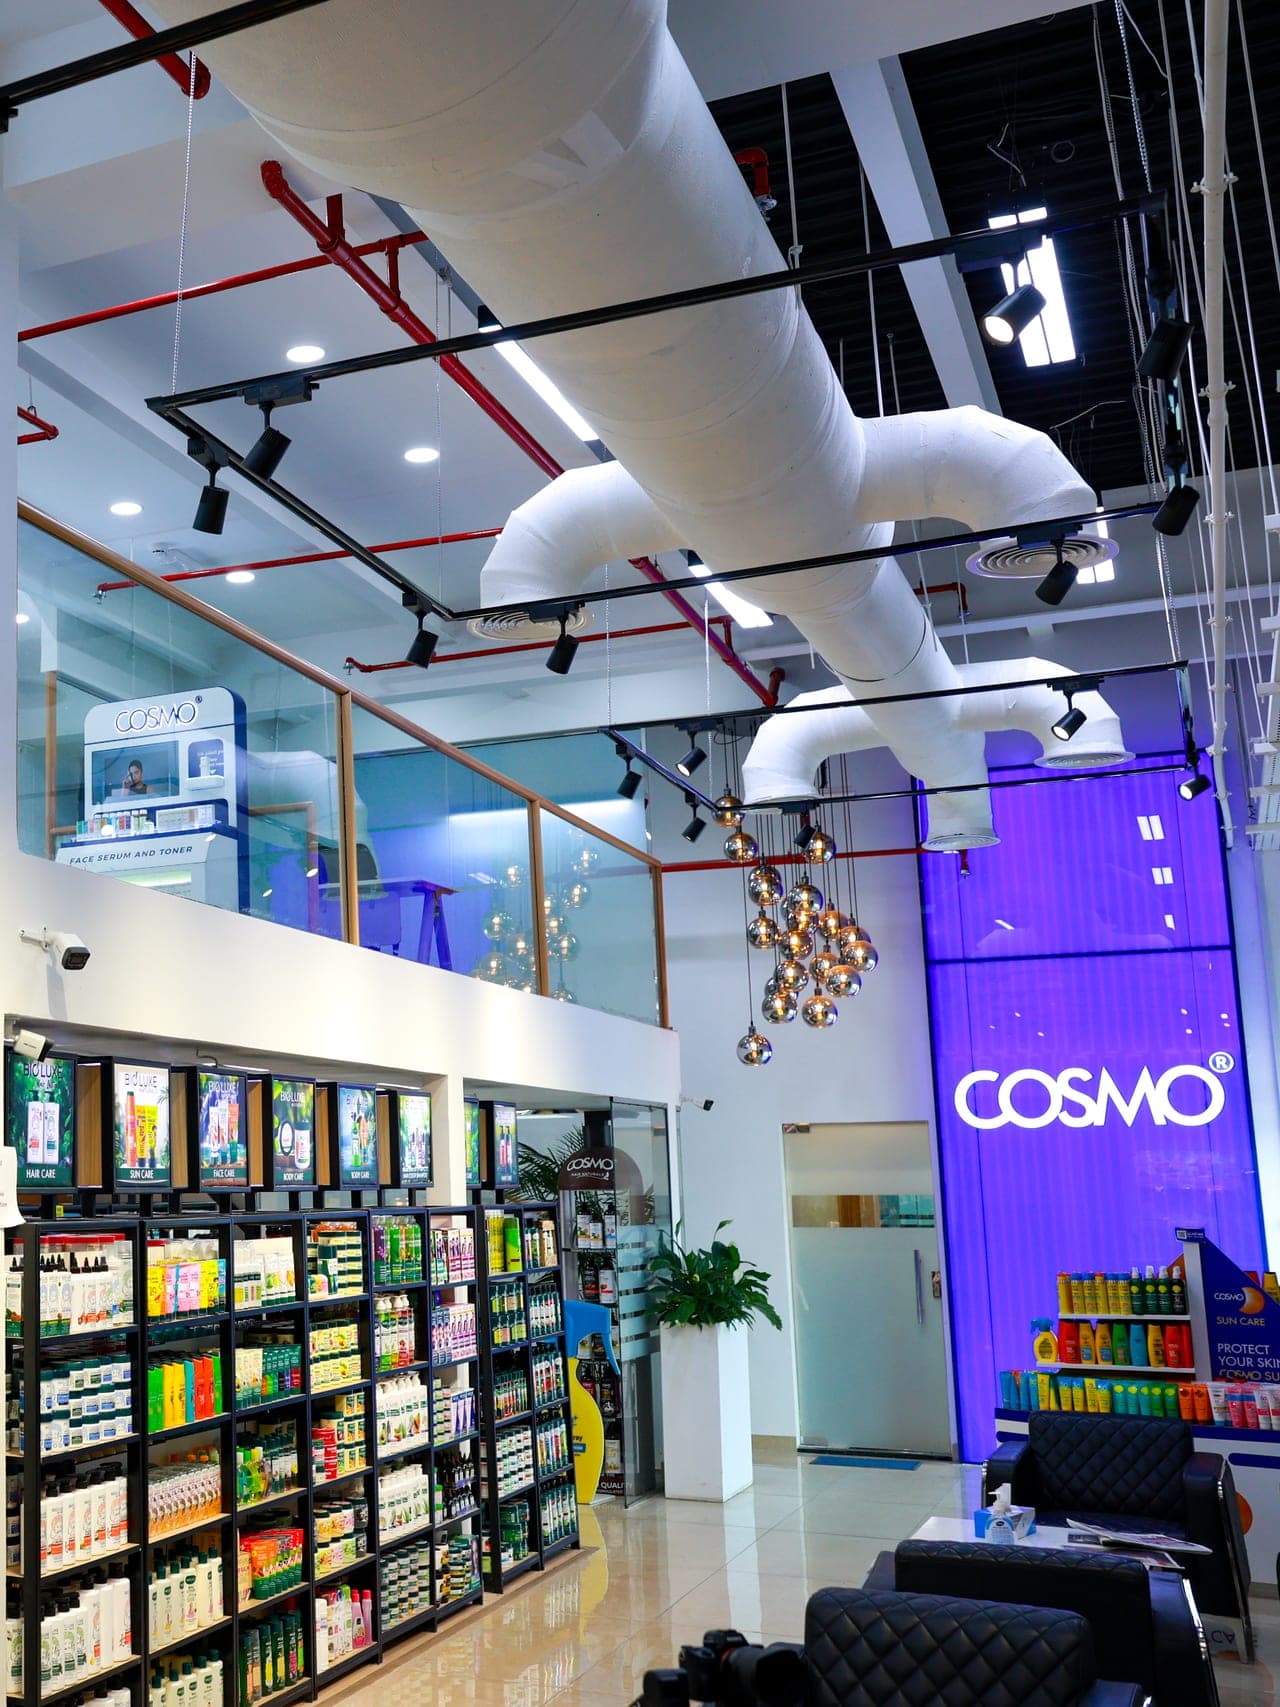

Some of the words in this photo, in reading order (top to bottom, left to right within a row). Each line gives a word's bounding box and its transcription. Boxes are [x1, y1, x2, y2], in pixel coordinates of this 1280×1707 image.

[69, 855, 95, 865] FACE
[97, 852, 131, 862] SERUM
[135, 849, 156, 858] AND
[159, 846, 193, 856] TONER
[566, 1157, 614, 1171] COSMO
[26, 1169, 40, 1178] HAIR
[41, 1169, 56, 1179] CARE
[130, 1170, 139, 1178] SUN
[140, 1170, 154, 1179] CARE
[224, 1169, 235, 1177] CARE
[1214, 1293, 1245, 1301] COSMO
[1216, 1316, 1237, 1325] SUN
[1240, 1317, 1265, 1326] CARE
[1218, 1343, 1270, 1355] PROTECT
[1219, 1356, 1255, 1367] YOUR
